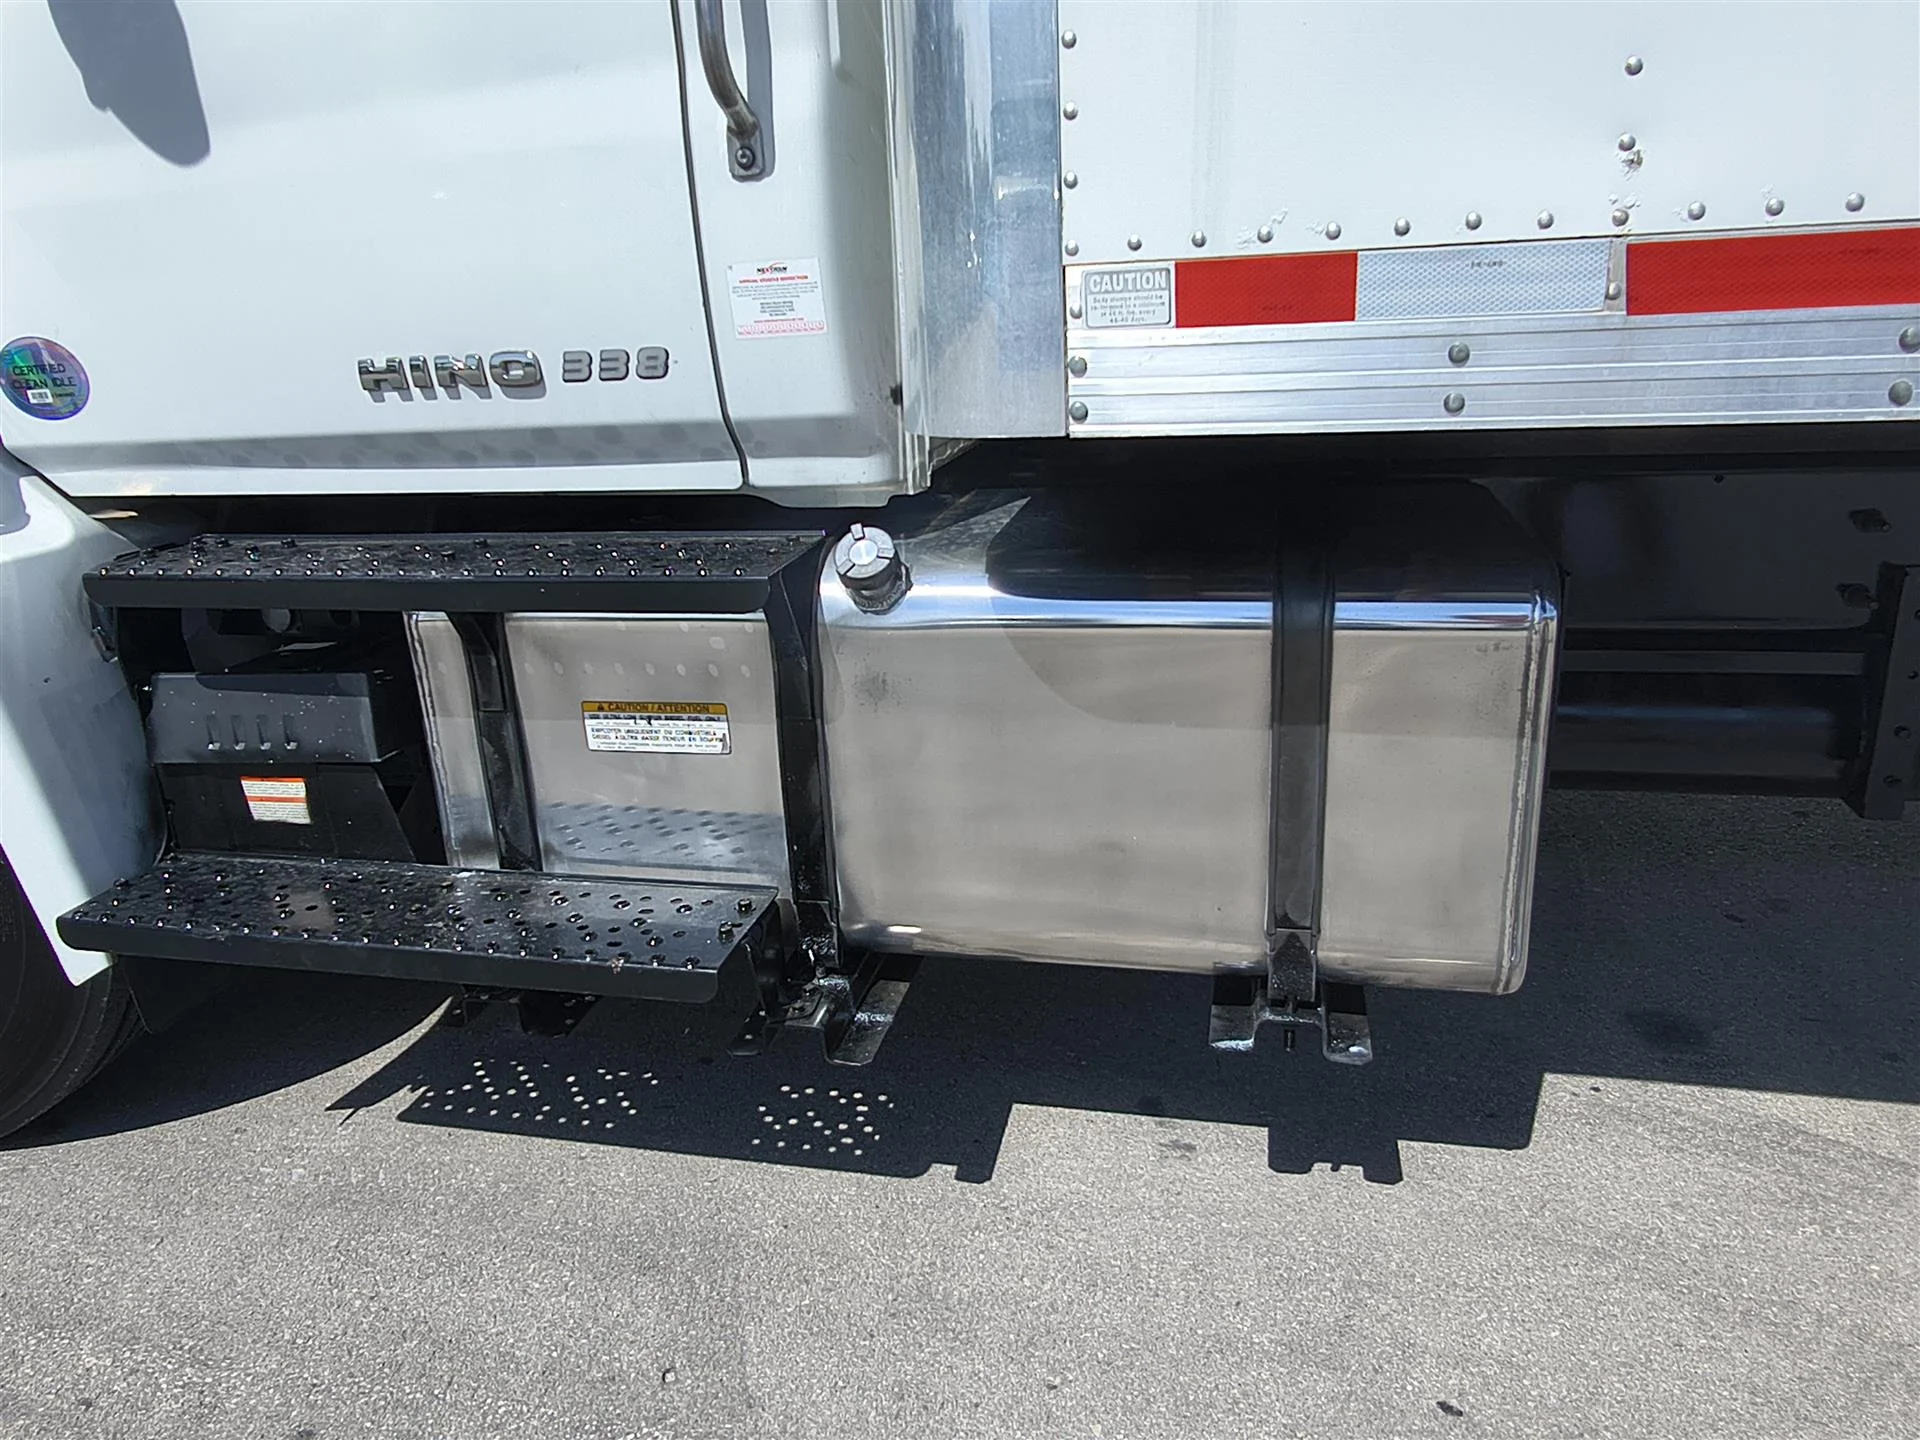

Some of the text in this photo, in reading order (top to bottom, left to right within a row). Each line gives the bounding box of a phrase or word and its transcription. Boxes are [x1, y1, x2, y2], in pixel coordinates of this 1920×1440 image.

[1089, 271, 1167, 293] CAUTION
[12, 363, 66, 376] CERTIFIED
[357, 346, 670, 395] HINO 338
[12, 376, 77, 389] CLEAN IDLE
[608, 703, 649, 712] CAUTION
[656, 704, 710, 713] ATTENTION
